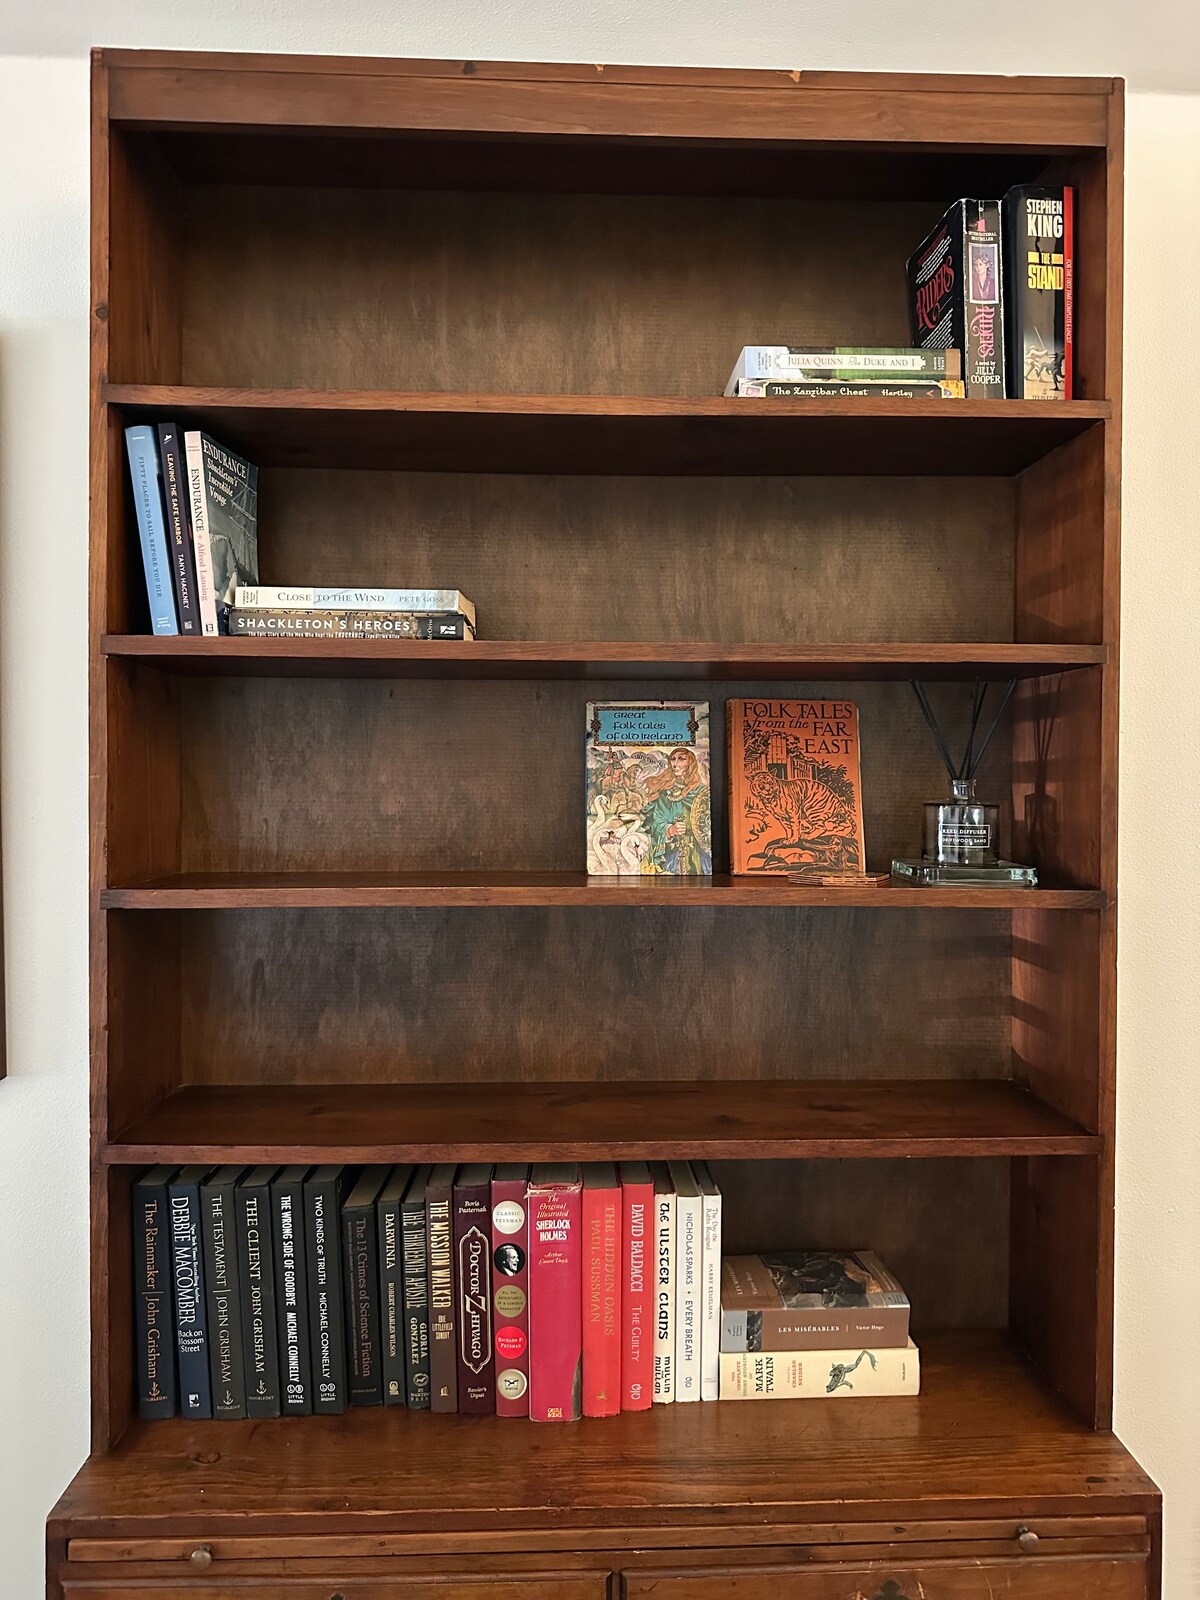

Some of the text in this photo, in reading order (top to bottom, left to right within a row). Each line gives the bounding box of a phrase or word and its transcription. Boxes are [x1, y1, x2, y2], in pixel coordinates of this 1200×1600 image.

[1026, 199, 1062, 214] STEPHEN
[1027, 214, 1063, 238] KING
[1028, 264, 1064, 290] STAND
[1041, 252, 1050, 264] THE
[916, 255, 954, 330] RIDERS
[970, 306, 995, 358] RIDERS
[788, 357, 810, 366] JULIA
[814, 357, 843, 366] QUINN
[864, 358, 886, 366] DUKE
[971, 375, 1001, 384] COOPER
[976, 366, 995, 375] JILLY
[772, 386, 869, 397] The Zanzibar Chest
[881, 388, 913, 398] Hartley
[202, 439, 247, 479] ENDURANCE
[206, 458, 238, 486] Shackleton's
[166, 453, 175, 482] LEAVING
[174, 518, 182, 545] HARBOR
[191, 468, 204, 532] ENDURANCE
[208, 472, 233, 497] Incredible
[209, 486, 228, 507] Voyage
[145, 509, 151, 519] TO
[150, 539, 158, 566] BEFORE
[198, 542, 208, 601] Alfred Lansing
[181, 577, 190, 609] HACKNEY
[277, 592, 312, 600] CLOSE
[355, 594, 384, 602] WIND
[238, 617, 410, 630] SHACKLETON'S HEROES
[614, 722, 636, 730] folk
[743, 702, 852, 719] FOLK TALES
[745, 710, 852, 736] from the FAR
[804, 739, 853, 754] EAST
[537, 1210, 569, 1218] Illustrated
[548, 1193, 559, 1202] The
[211, 1195, 227, 1286] THE TESTAMENT
[246, 1198, 260, 1280] THE CLIENT
[314, 1195, 326, 1284] TWO KINDS OF TRUTH
[355, 1218, 367, 1238] The
[385, 1214, 396, 1269] DARWINIA
[536, 1219, 570, 1230] SHERLOCK
[540, 1231, 567, 1241] HOLMES
[144, 1200, 159, 1288] The Rainmaker
[171, 1196, 196, 1326] DEBBIE MACOMBER
[280, 1195, 296, 1306] THE WRONG SIDE OF GOODBYE
[356, 1240, 367, 1251] 13
[402, 1210, 428, 1309] THE THIRTEENTH APOSTLE
[430, 1200, 451, 1308] THE MISSION WALKER
[630, 1203, 644, 1292] DAVID BALDACCI
[685, 1212, 693, 1285] NICHOLAS SPARKS
[357, 1253, 369, 1288] Crimes
[591, 1220, 601, 1322] PAUL SUSSMAN
[604, 1204, 615, 1336] THE HIDDEN OASIS
[359, 1289, 370, 1300] of
[465, 1242, 486, 1358] DOCTOR ZHIVAGO
[146, 1297, 160, 1379] John Grisham
[215, 1296, 231, 1383] JOHN GRISHAM
[250, 1285, 264, 1372] JOHN GRISHAM
[318, 1292, 330, 1378] MICHAEL CONNELLY
[360, 1302, 371, 1340] Science
[631, 1305, 642, 1362] THE GUILTY
[286, 1312, 300, 1382] MICHAEL CONNELLY
[362, 1342, 372, 1377] Fiction
[410, 1317, 419, 1364] GONZALEZ
